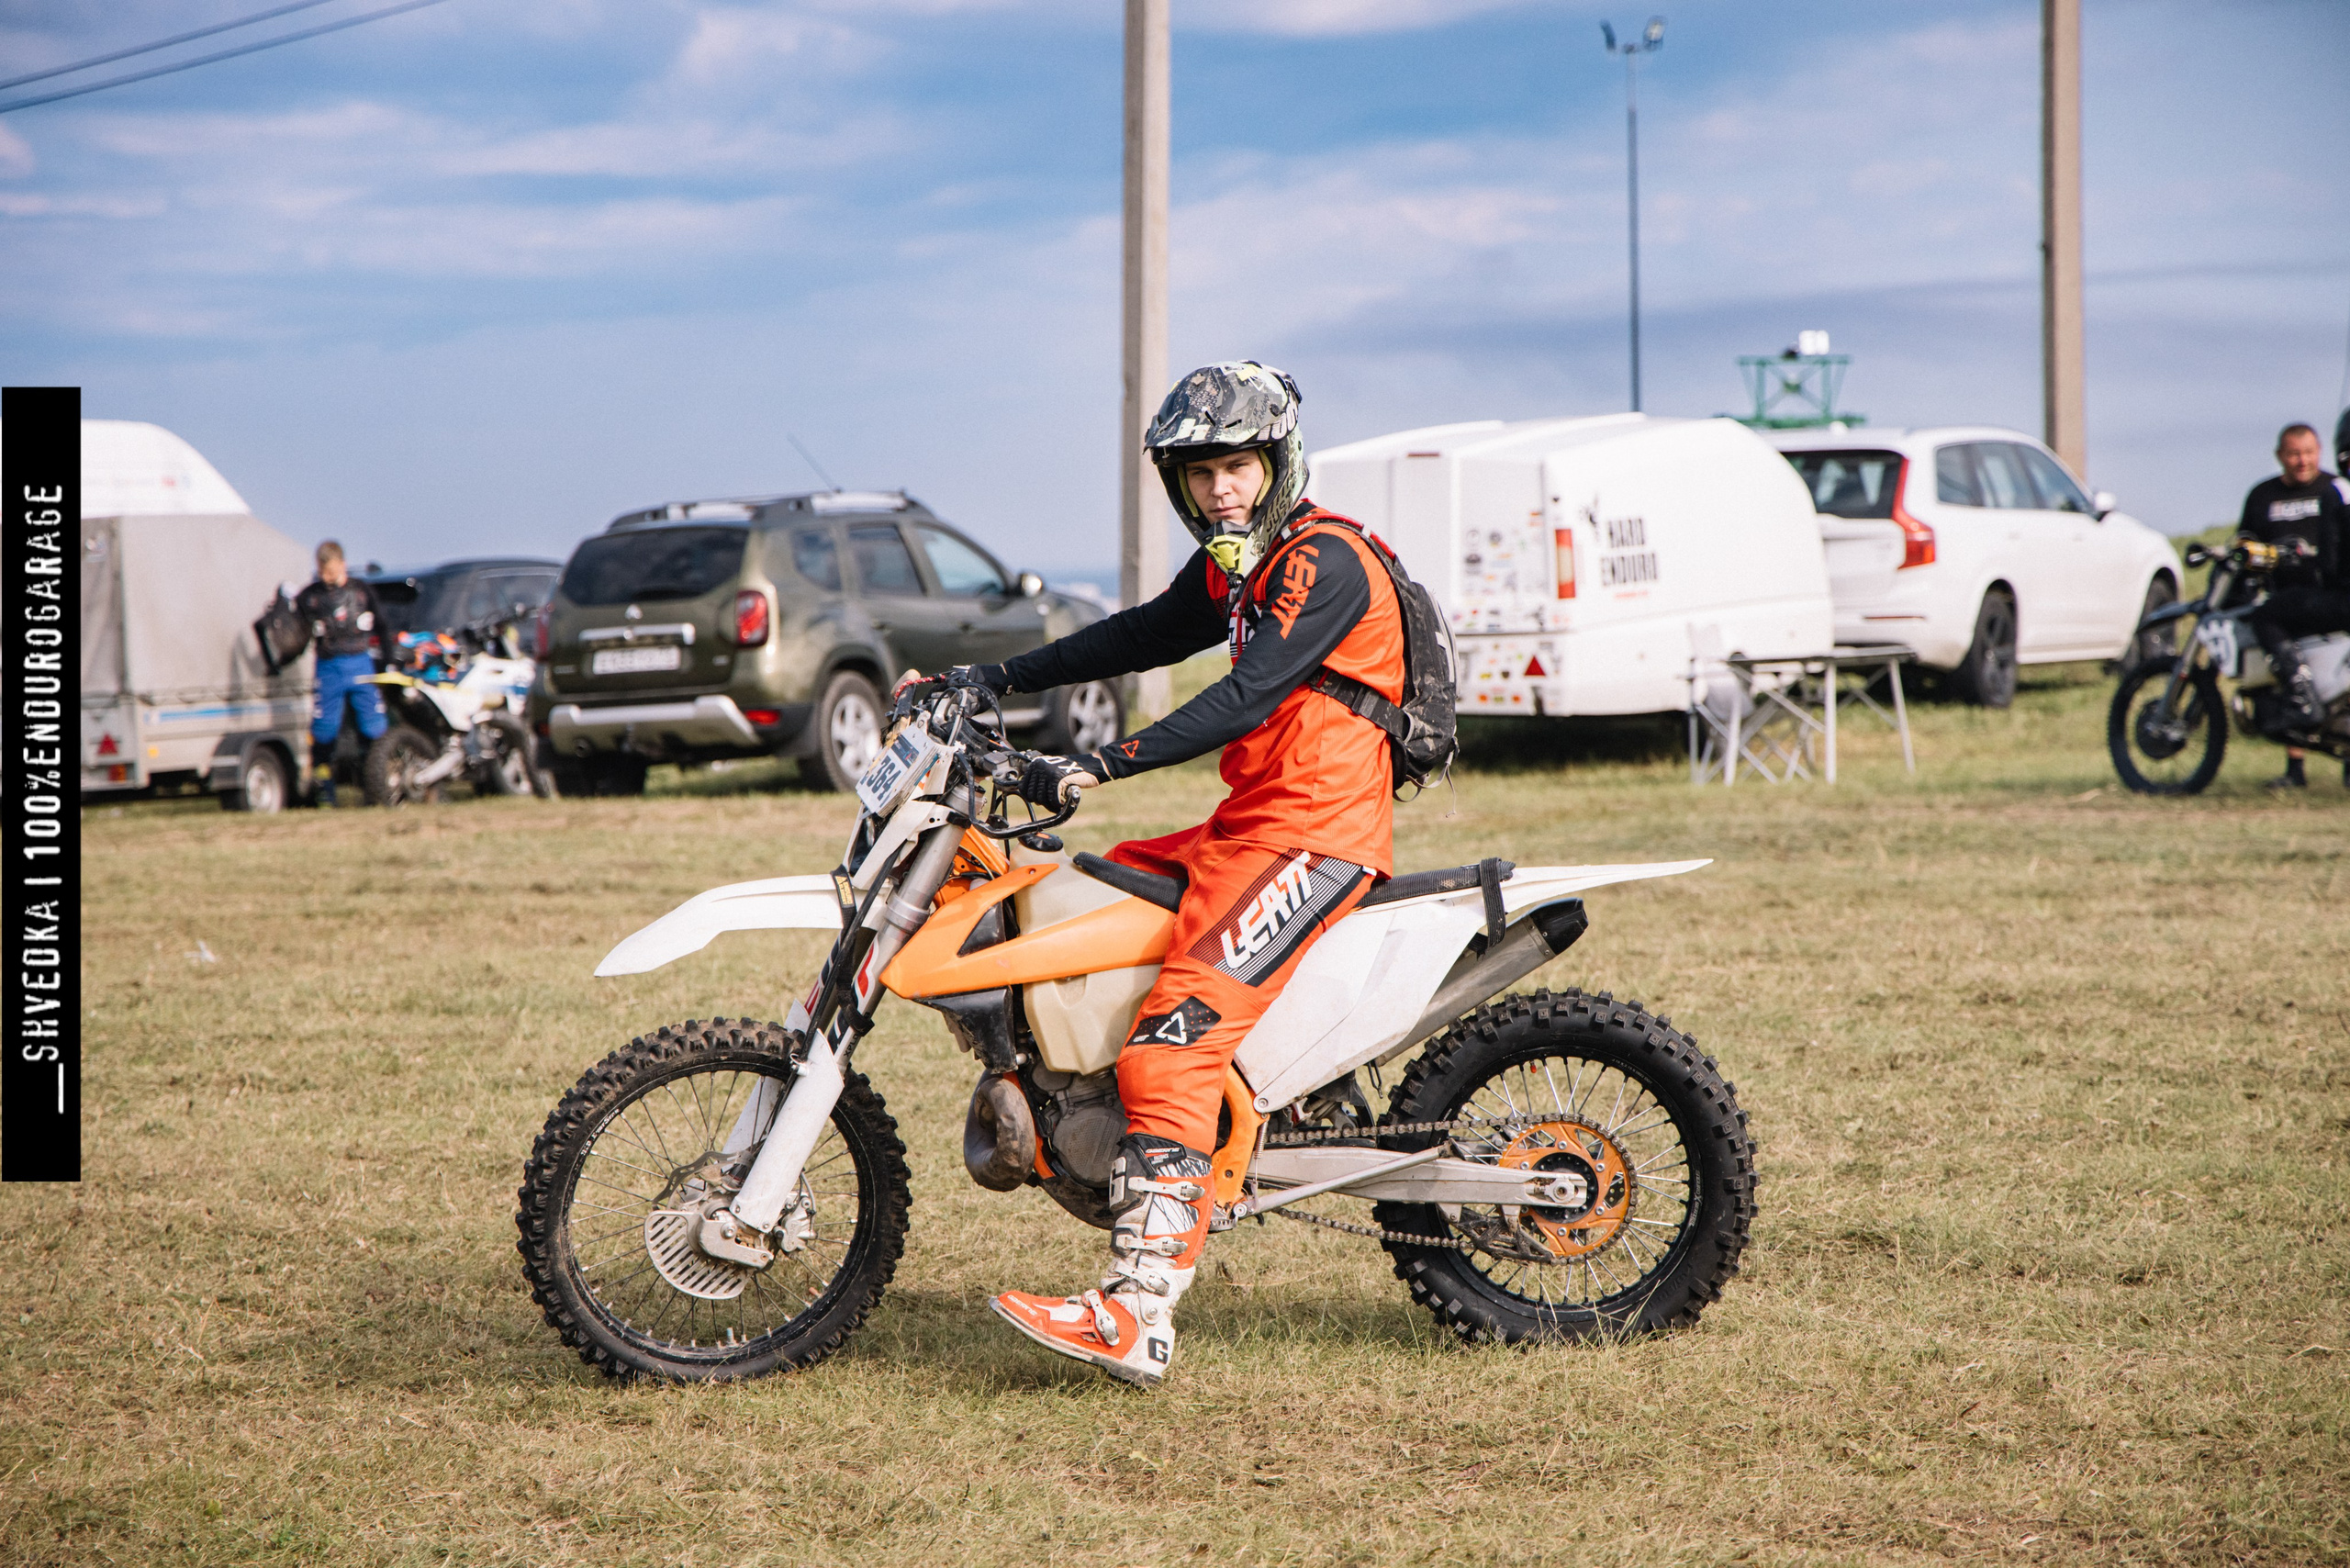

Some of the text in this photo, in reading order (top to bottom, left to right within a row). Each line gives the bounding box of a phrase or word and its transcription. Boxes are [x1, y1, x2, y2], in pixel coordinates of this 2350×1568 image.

[866, 756, 901, 801] 364
[843, 1034, 859, 1057] XPLO
[1147, 1337, 1168, 1365] G
